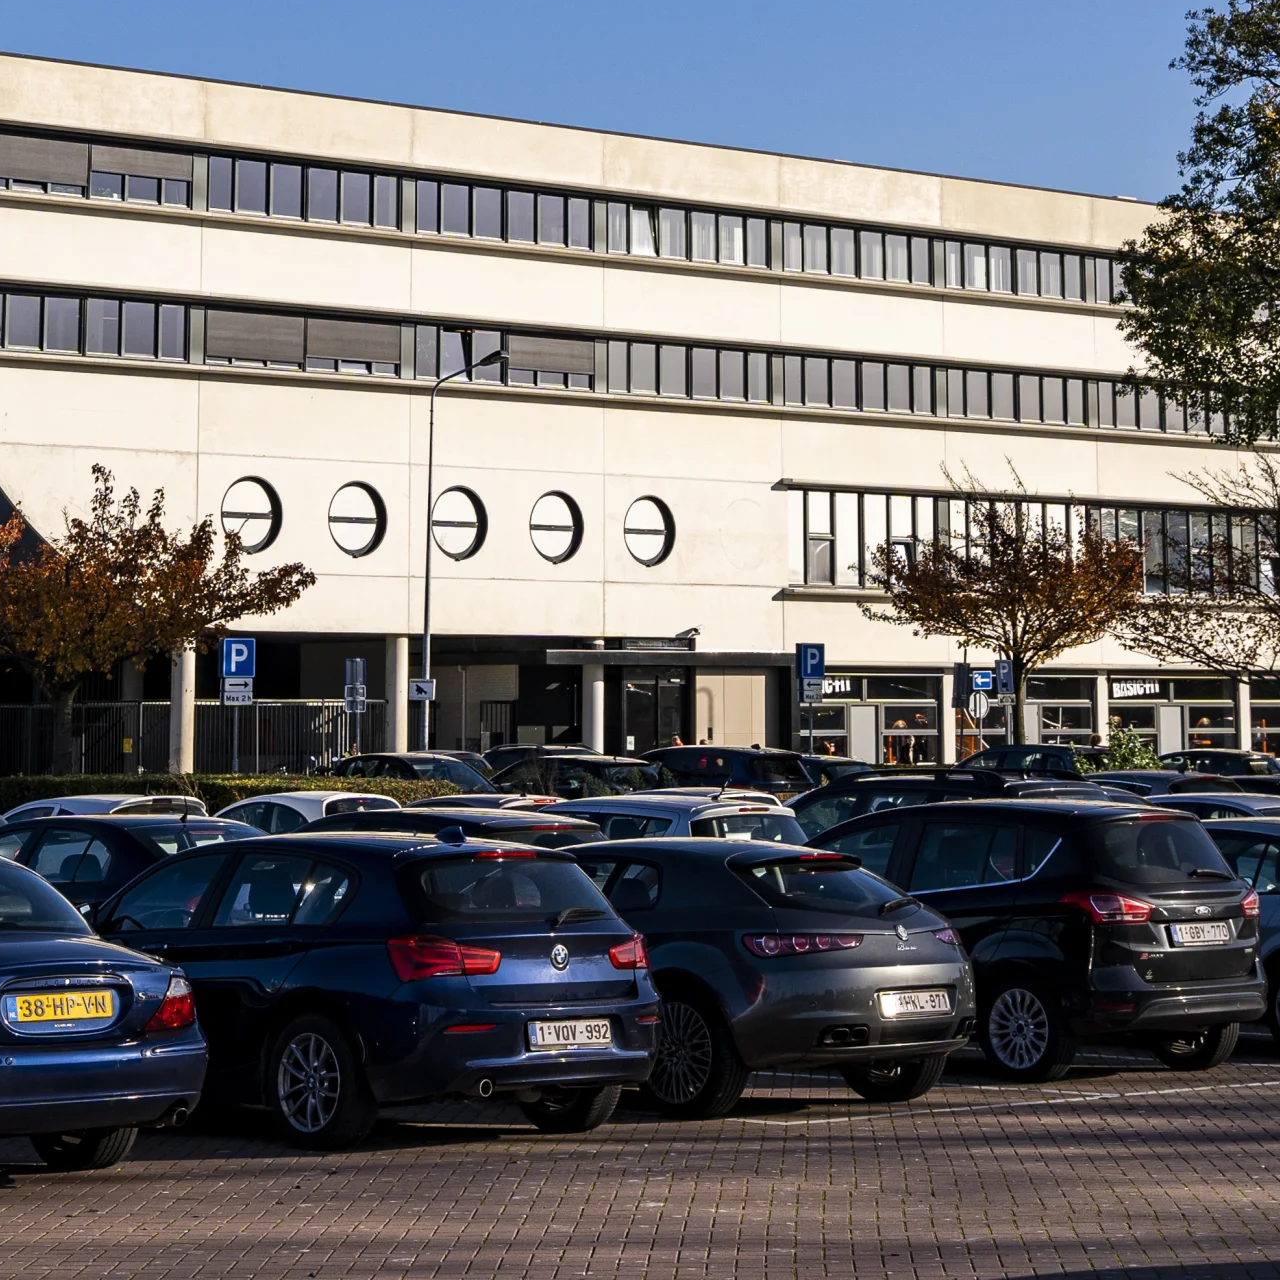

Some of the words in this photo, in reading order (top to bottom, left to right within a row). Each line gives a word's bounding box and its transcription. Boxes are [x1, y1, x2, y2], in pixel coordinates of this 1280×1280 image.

[231, 644, 248, 672] P
[807, 648, 820, 674] P
[1112, 680, 1160, 698] BASIC-FIT
[1178, 923, 1228, 940] 1-GBY-770
[22, 995, 107, 1018] 38-HP-VN
[539, 1023, 609, 1042] 1-VQV-992
